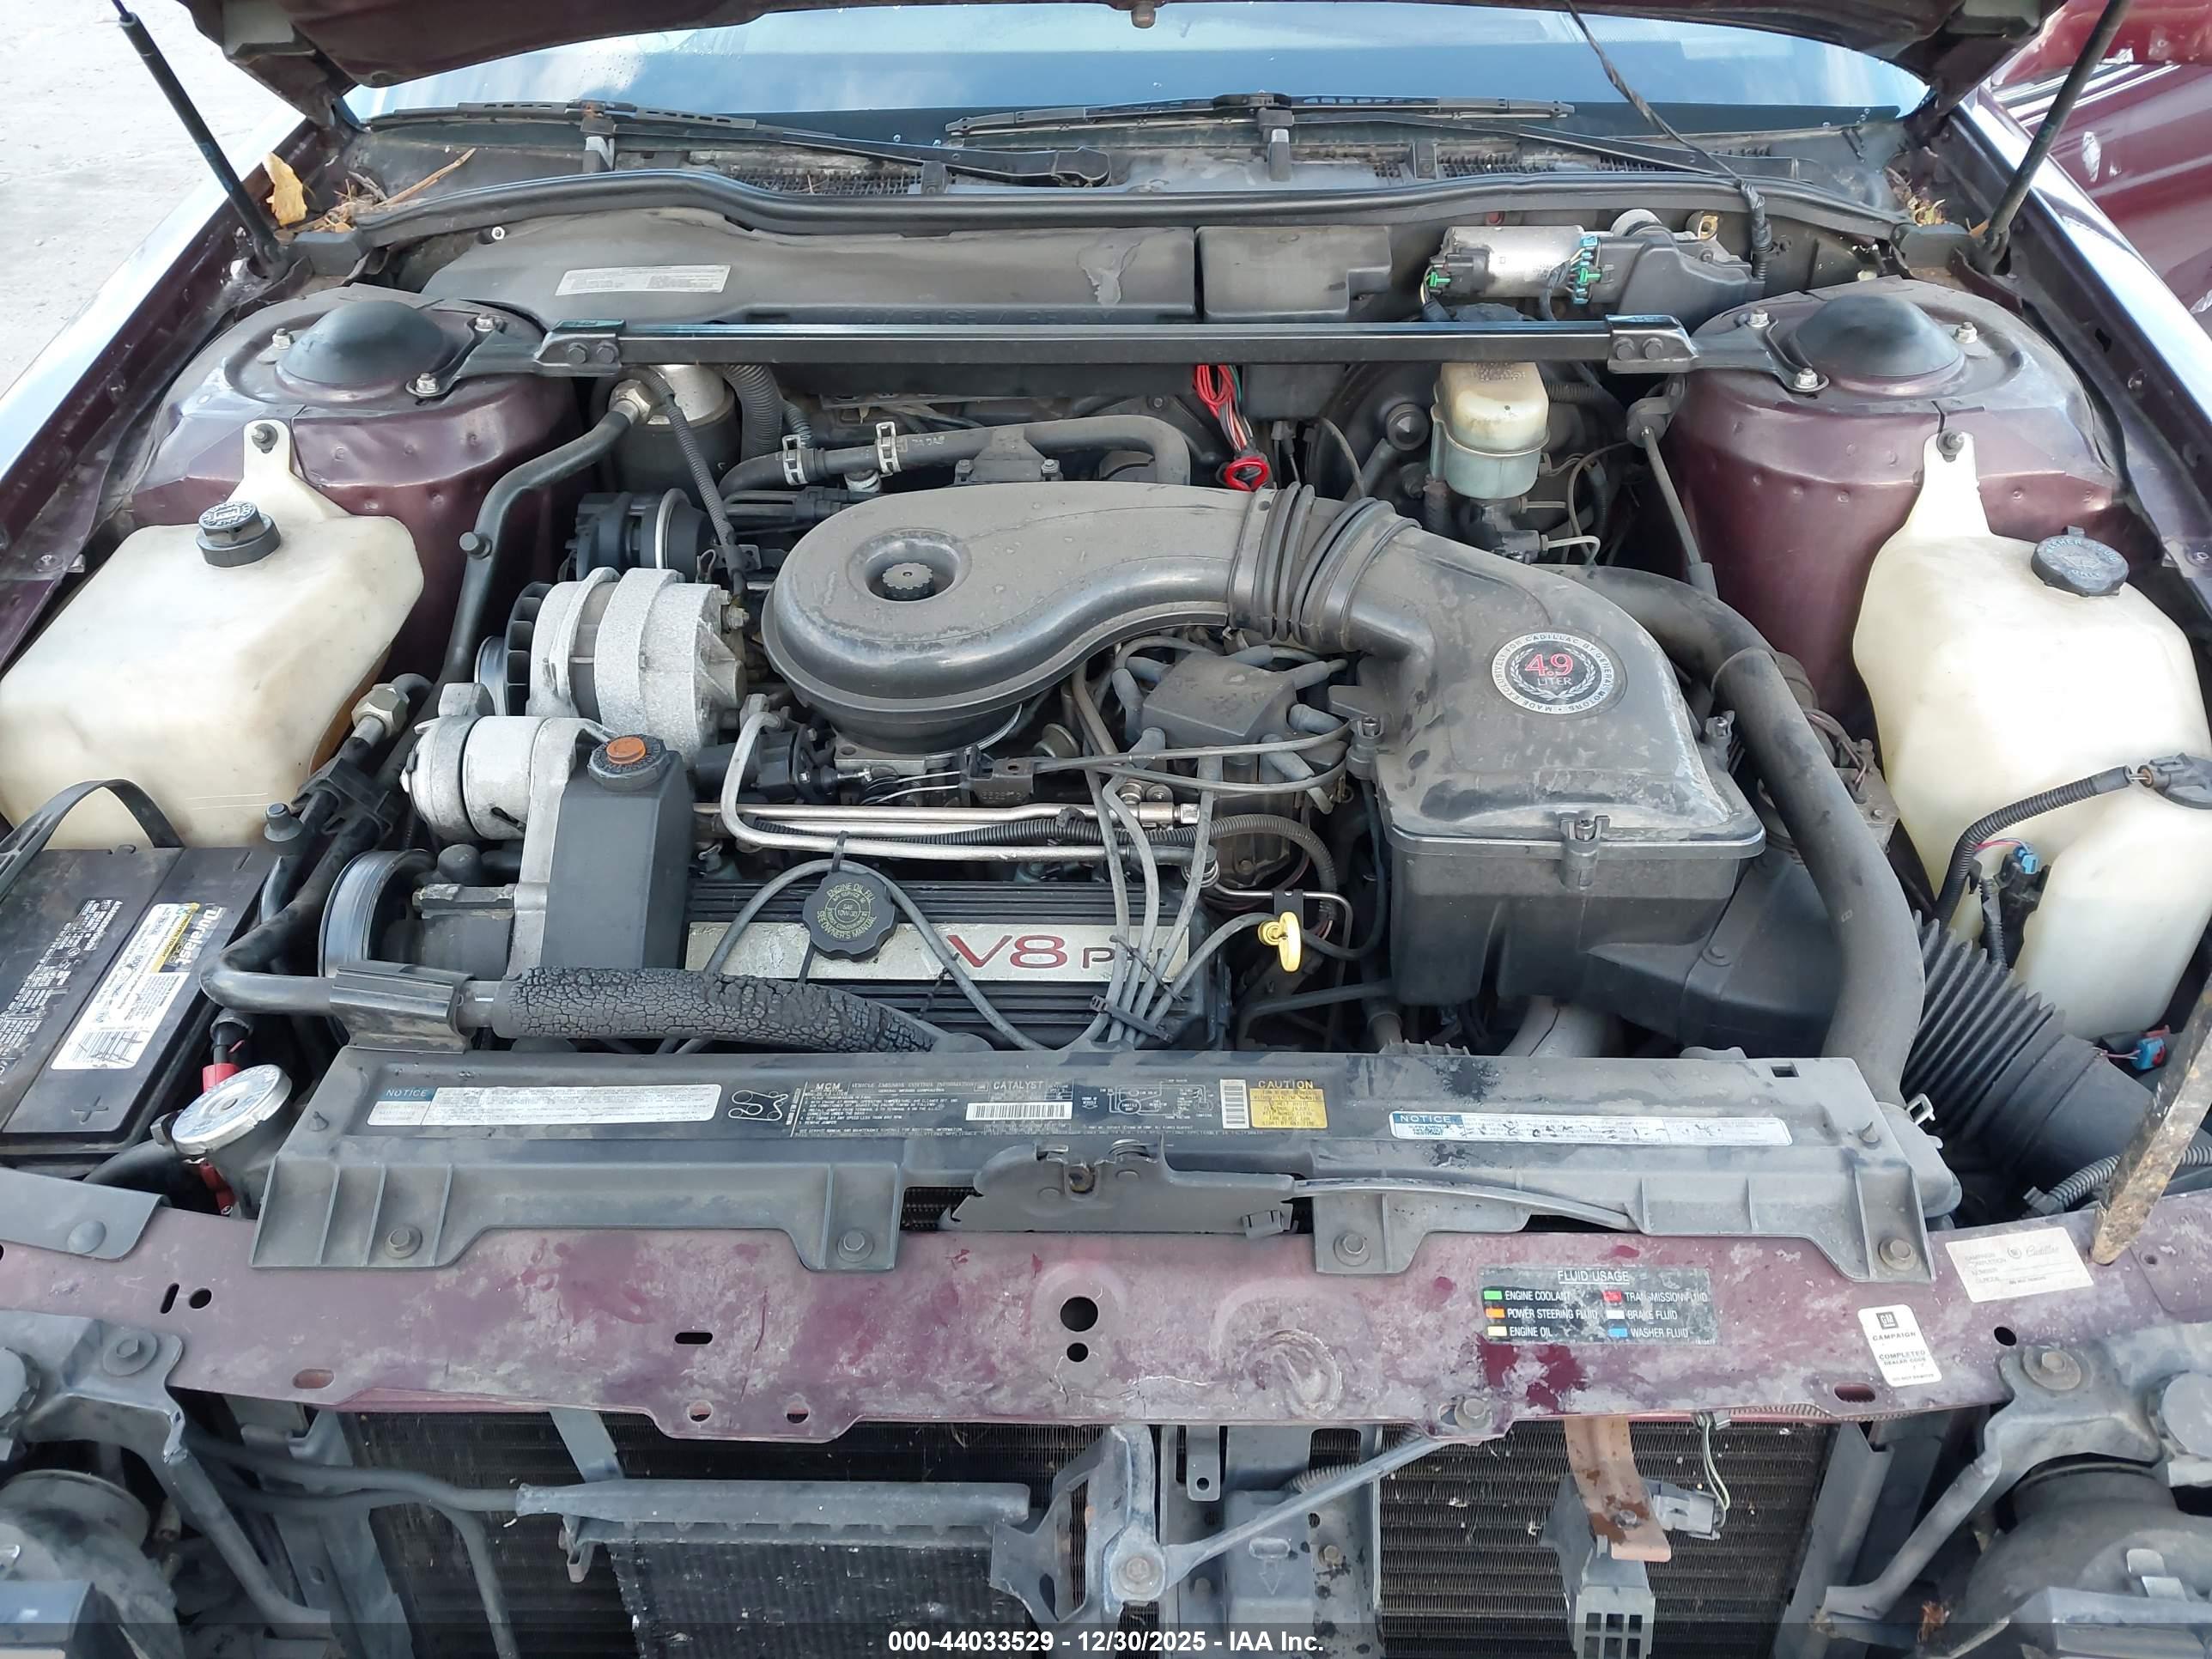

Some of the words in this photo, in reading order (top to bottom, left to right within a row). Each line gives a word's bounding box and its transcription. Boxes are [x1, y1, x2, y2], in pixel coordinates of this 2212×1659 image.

[1525, 634, 1579, 644] CADILLAC
[1582, 642, 1595, 652] BY
[1525, 653, 1574, 677] 4.9
[1537, 677, 1573, 686] LITER
[826, 882, 853, 898] ENGINE
[854, 883, 864, 893] OIL
[864, 890, 876, 901] FILL
[817, 910, 826, 923] SEE
[852, 915, 878, 938] MANUAL
[174, 907, 223, 965] Duralast
[947, 934, 1068, 969] V8
[994, 1080, 1044, 1090] CATALYST
[1258, 1080, 1314, 1089] CAUTION
[386, 1089, 428, 1097] NOTICE
[1400, 1115, 1451, 1123] NOTICE
[1558, 1271, 1589, 1281] FLUID
[1592, 1271, 1629, 1282] USAGE
[1504, 1291, 1534, 1301] ENGINE
[1534, 1291, 1571, 1301] COOLANT
[1507, 1309, 1535, 1319] POWER
[1536, 1309, 1574, 1320] STEERING
[1576, 1309, 1598, 1320] FLUID
[1656, 1310, 1678, 1320] FLUID
[1878, 1312, 1897, 1328] GM
[1509, 1326, 1541, 1337] ENGINE
[1540, 1326, 1553, 1338] OIL
[1631, 1328, 1665, 1338] WASHER
[1667, 1328, 1689, 1338] FLUID
[1872, 1332, 1917, 1341] CAMPAIGN
[1879, 1349, 1926, 1360] COMPLETED
